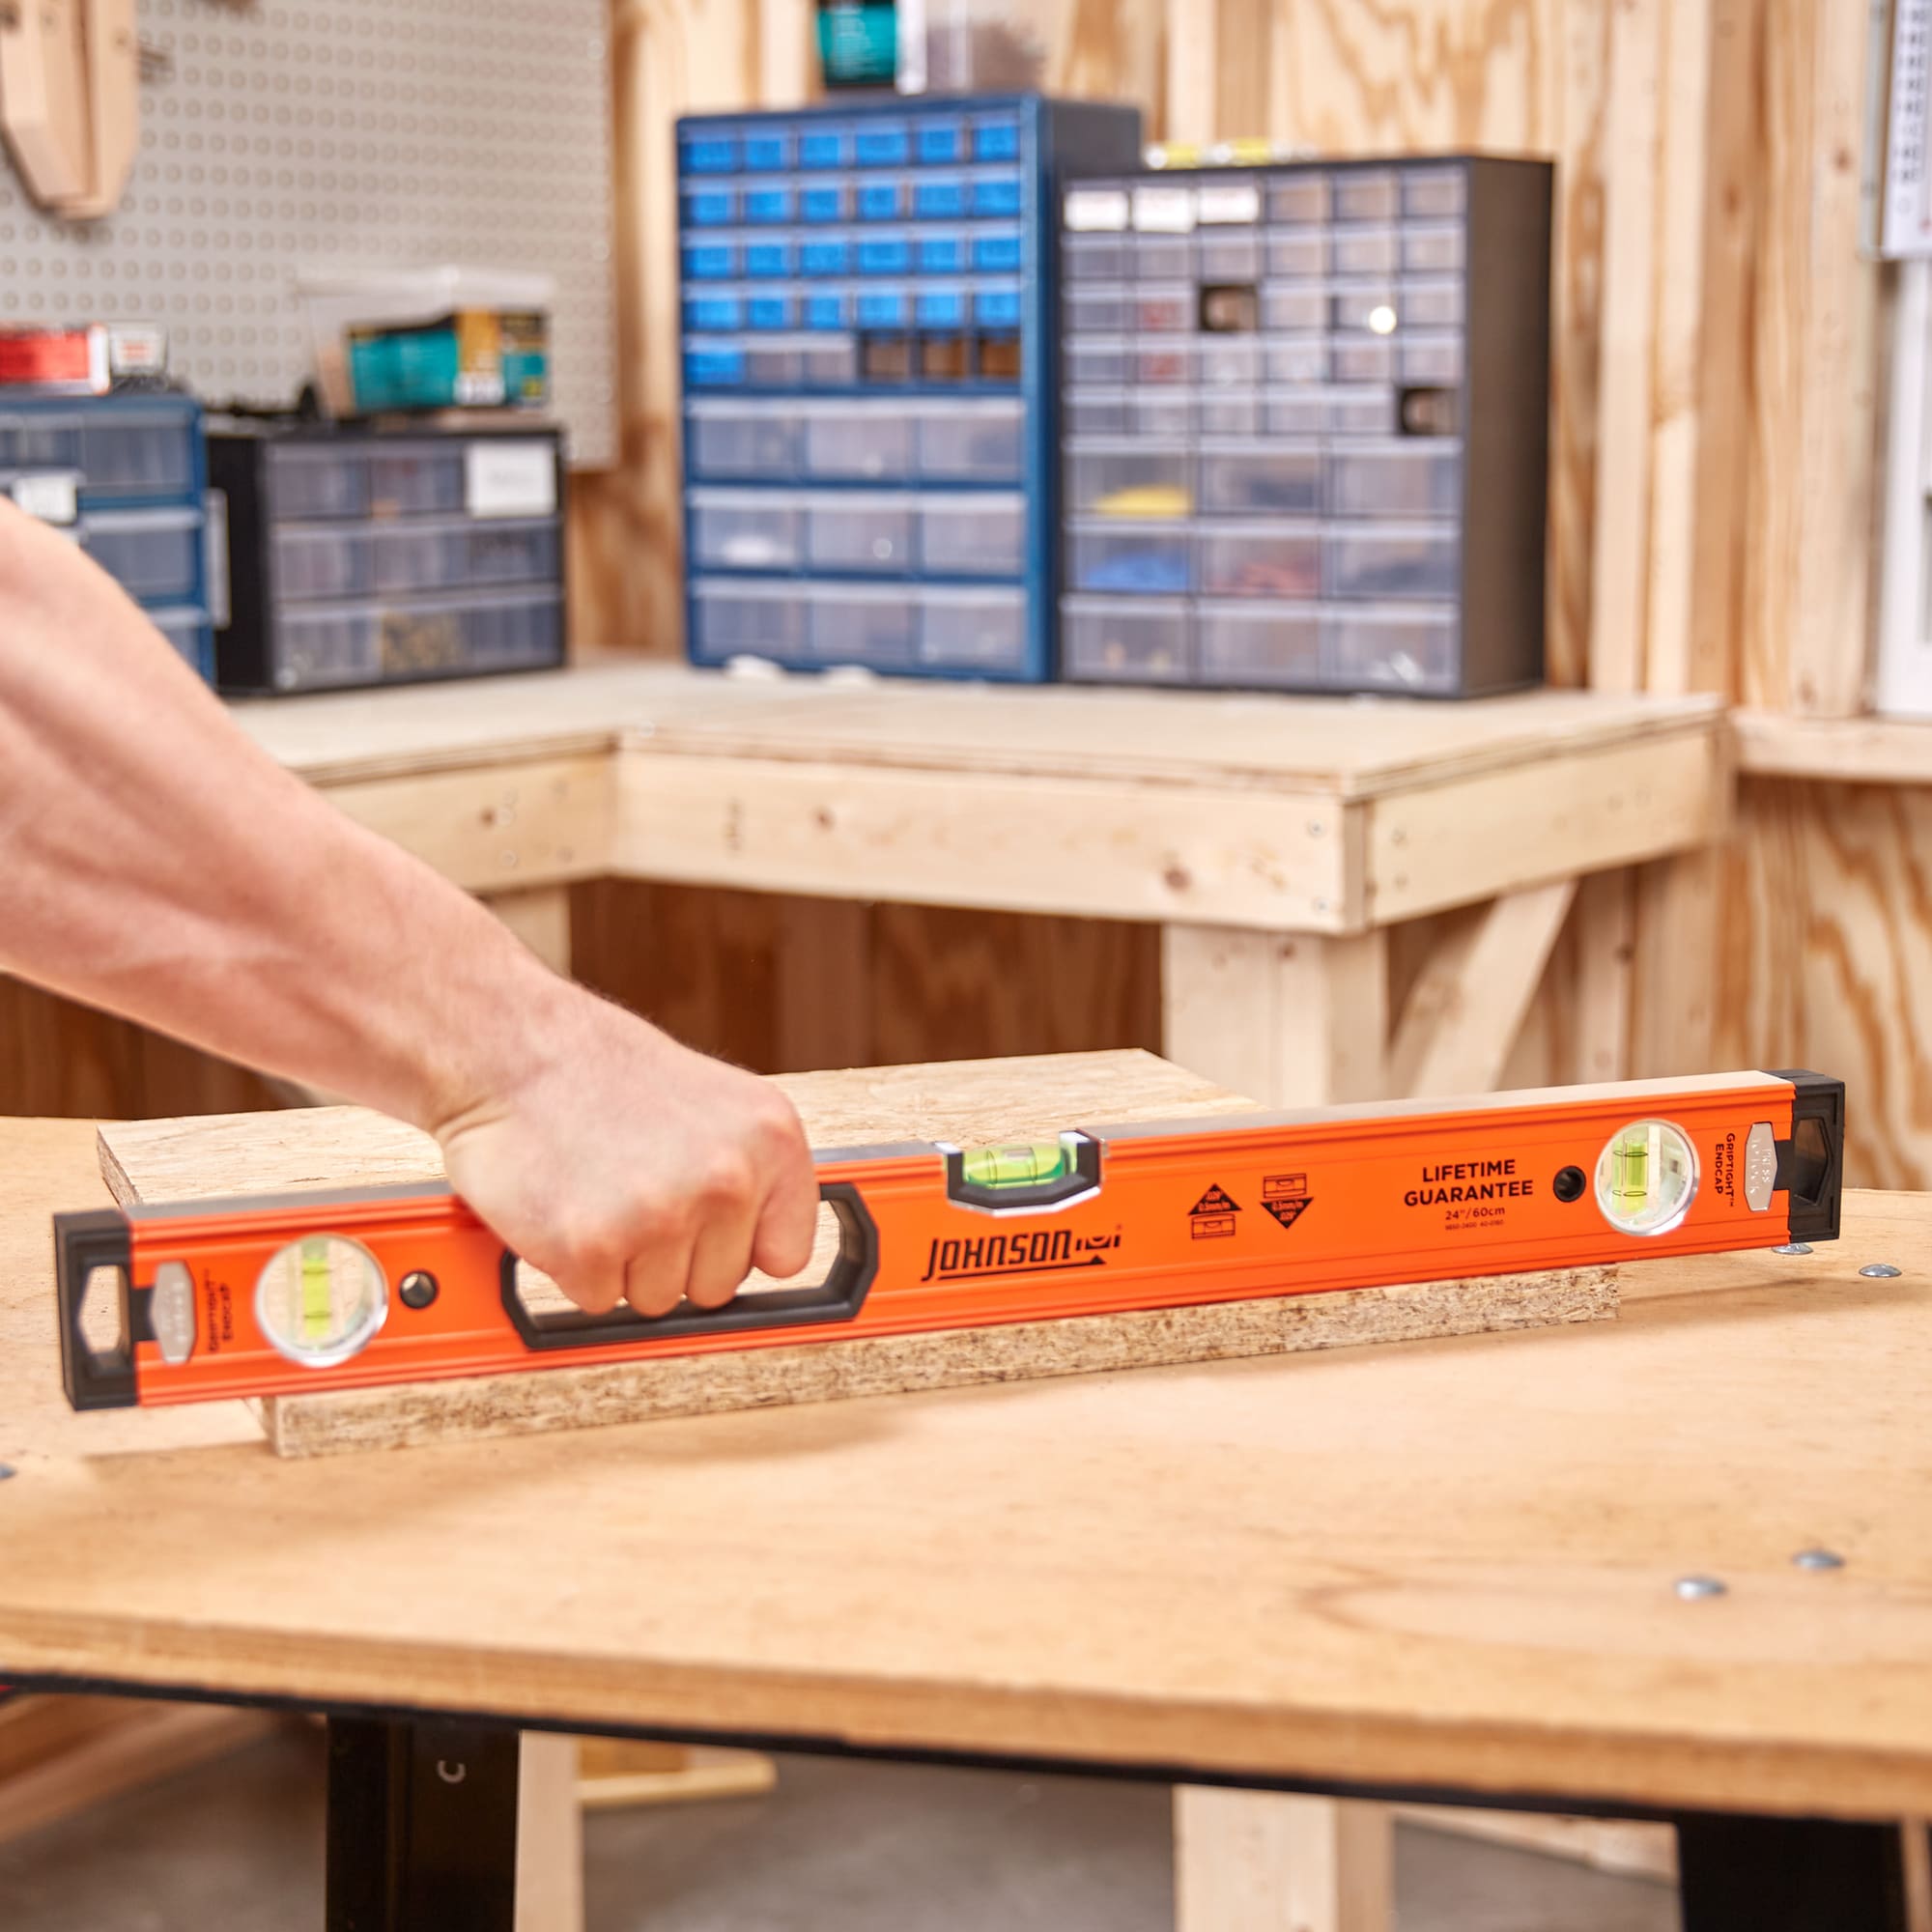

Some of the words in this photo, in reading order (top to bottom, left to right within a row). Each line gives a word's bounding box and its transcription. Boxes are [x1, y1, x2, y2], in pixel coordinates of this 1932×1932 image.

[1422, 1159, 1516, 1182] LIFETIME
[1404, 1179, 1534, 1207] GUARANTEE
[921, 1230, 1072, 1282] JOHNSON
